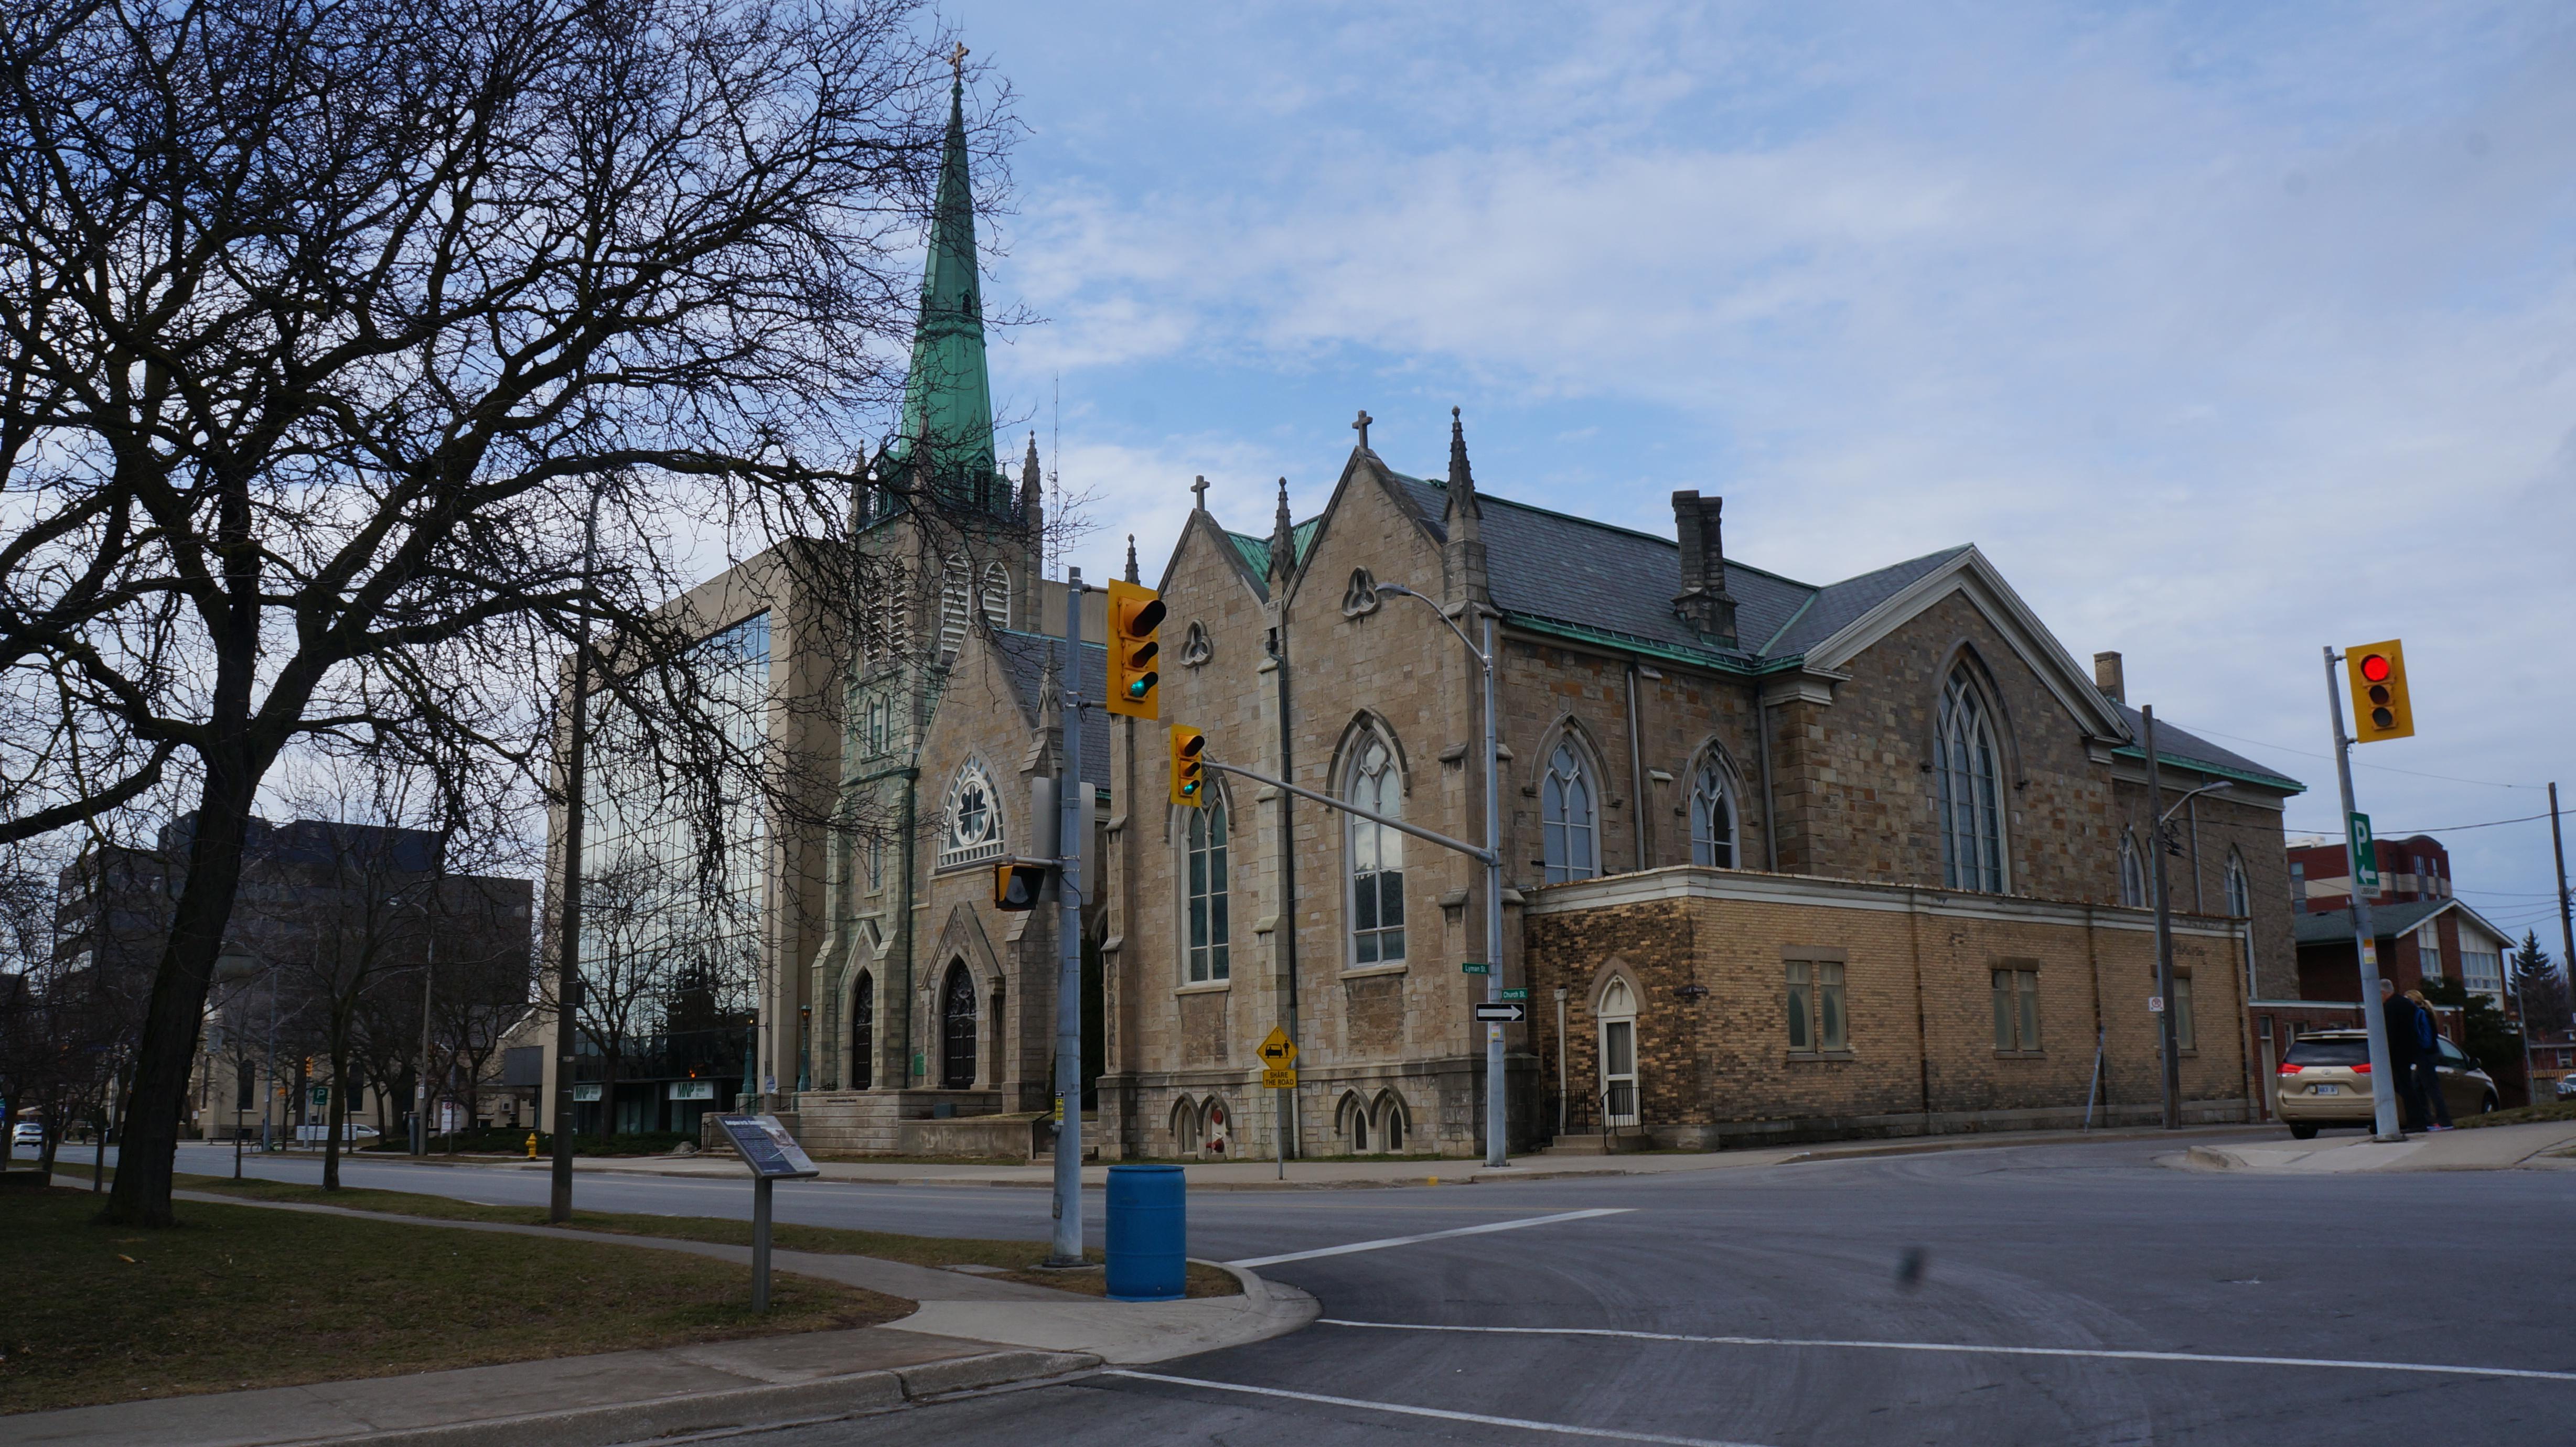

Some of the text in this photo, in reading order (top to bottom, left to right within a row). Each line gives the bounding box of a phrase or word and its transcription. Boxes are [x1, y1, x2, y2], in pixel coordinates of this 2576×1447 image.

[2355, 820, 2368, 856] P
[1465, 965, 1480, 973] Lyman
[317, 1089, 325, 1098] P
[575, 1086, 589, 1099] MNP
[677, 1083, 694, 1098] MNP
